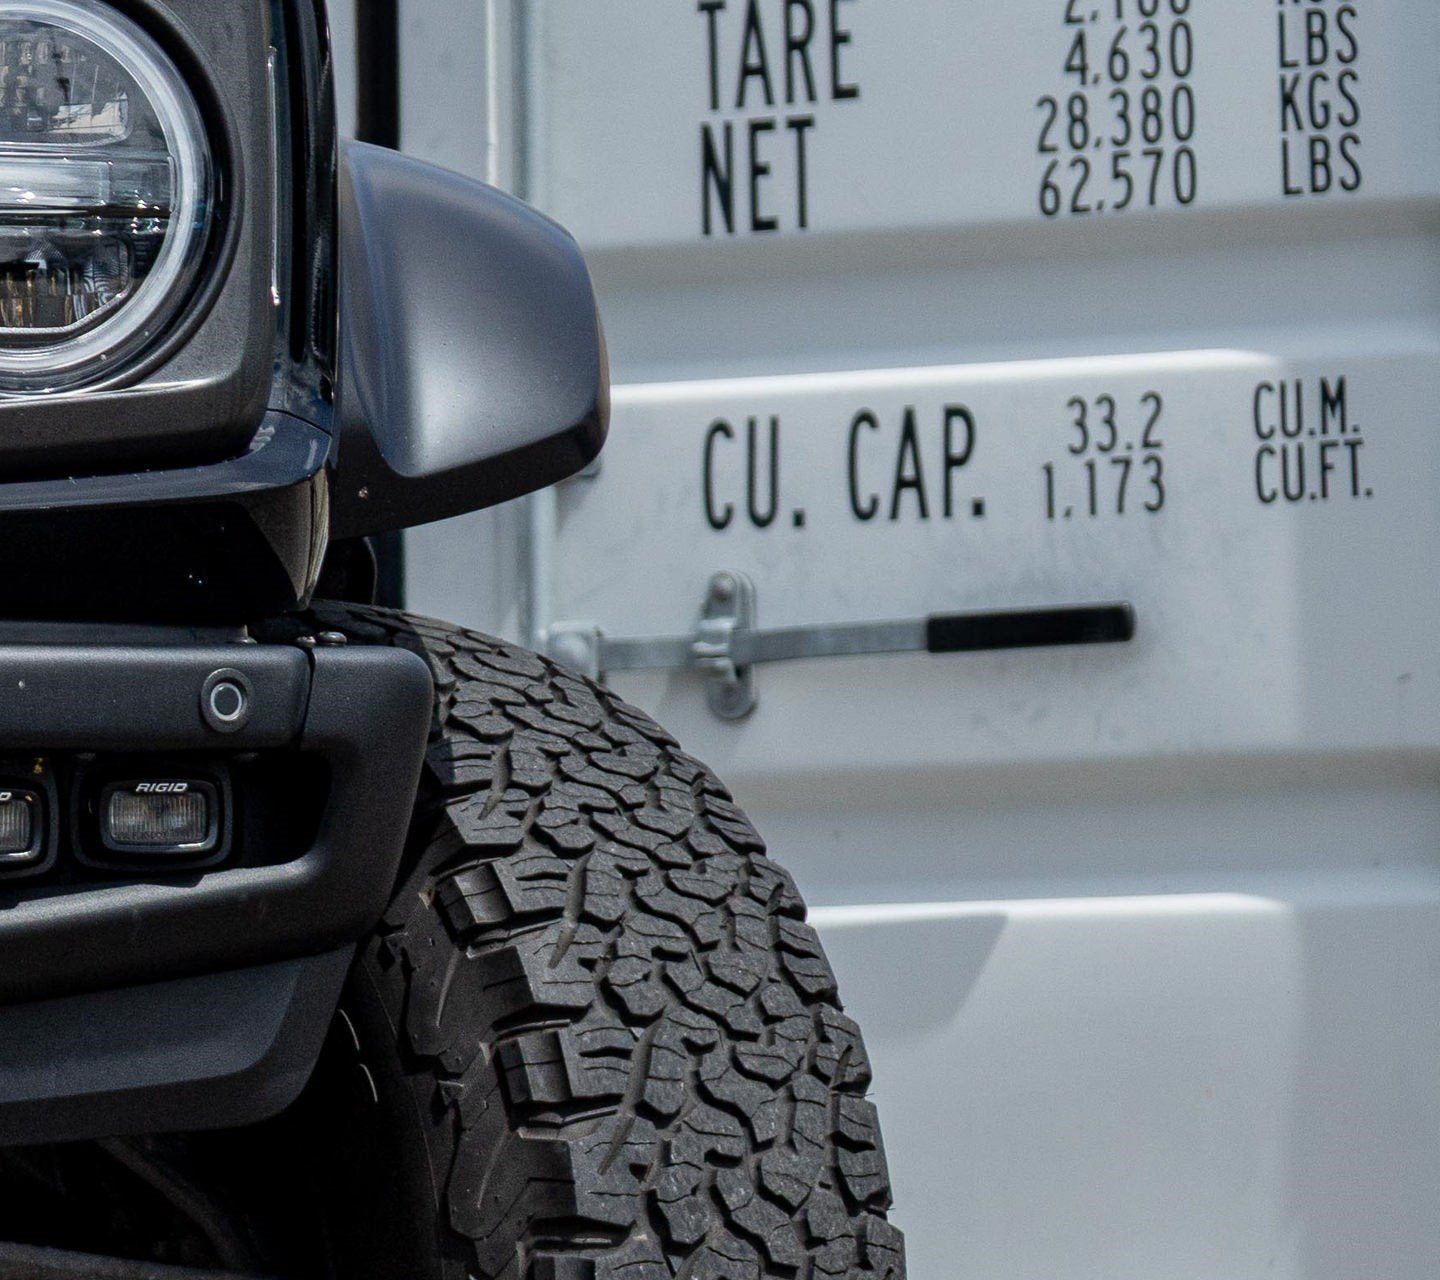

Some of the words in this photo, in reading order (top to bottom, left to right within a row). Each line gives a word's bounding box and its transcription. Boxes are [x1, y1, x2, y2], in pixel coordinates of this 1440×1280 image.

[1064, 19, 1194, 87] 4,630
[1278, 4, 1359, 69] LBS
[1036, 81, 1195, 153] 28,380
[1280, 68, 1361, 132] KGS
[699, 114, 816, 236] NET
[1039, 144, 1197, 216] 62,570
[1282, 131, 1363, 196] LBS
[1066, 389, 1163, 455] 33.2
[1253, 374, 1361, 440] CU.M.
[702, 415, 807, 532] CU.
[847, 403, 988, 522] CAP.
[1042, 453, 1166, 520] 1,173
[1255, 437, 1374, 504] CU.FT.
[134, 782, 189, 793] RIGID
